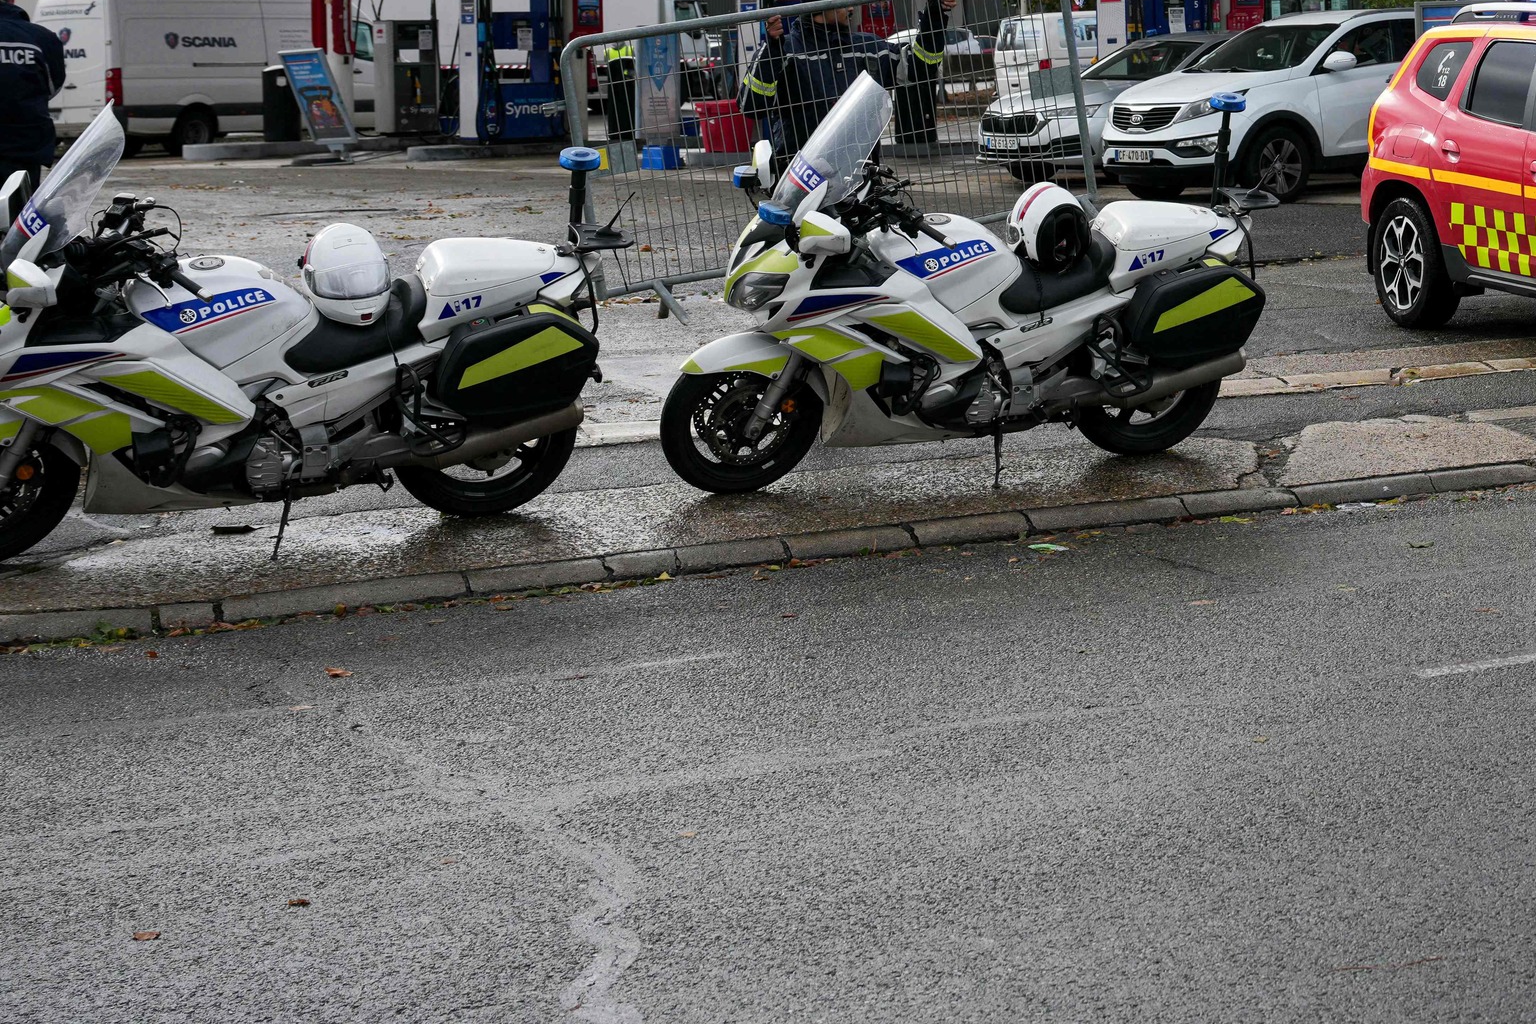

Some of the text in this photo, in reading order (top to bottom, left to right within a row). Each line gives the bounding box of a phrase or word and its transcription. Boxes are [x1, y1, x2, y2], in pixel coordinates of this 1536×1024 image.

[1193, 0, 1199, 9] 5
[181, 36, 238, 48] SCANIA
[0, 49, 36, 65] LICE
[64, 48, 87, 59] NIA
[1437, 74, 1448, 87] 18
[1118, 150, 1149, 161] CF-470-DA
[939, 240, 991, 268] POLICE
[1147, 249, 1166, 263] 17
[200, 289, 268, 320] POLICE
[460, 295, 483, 310] 17
